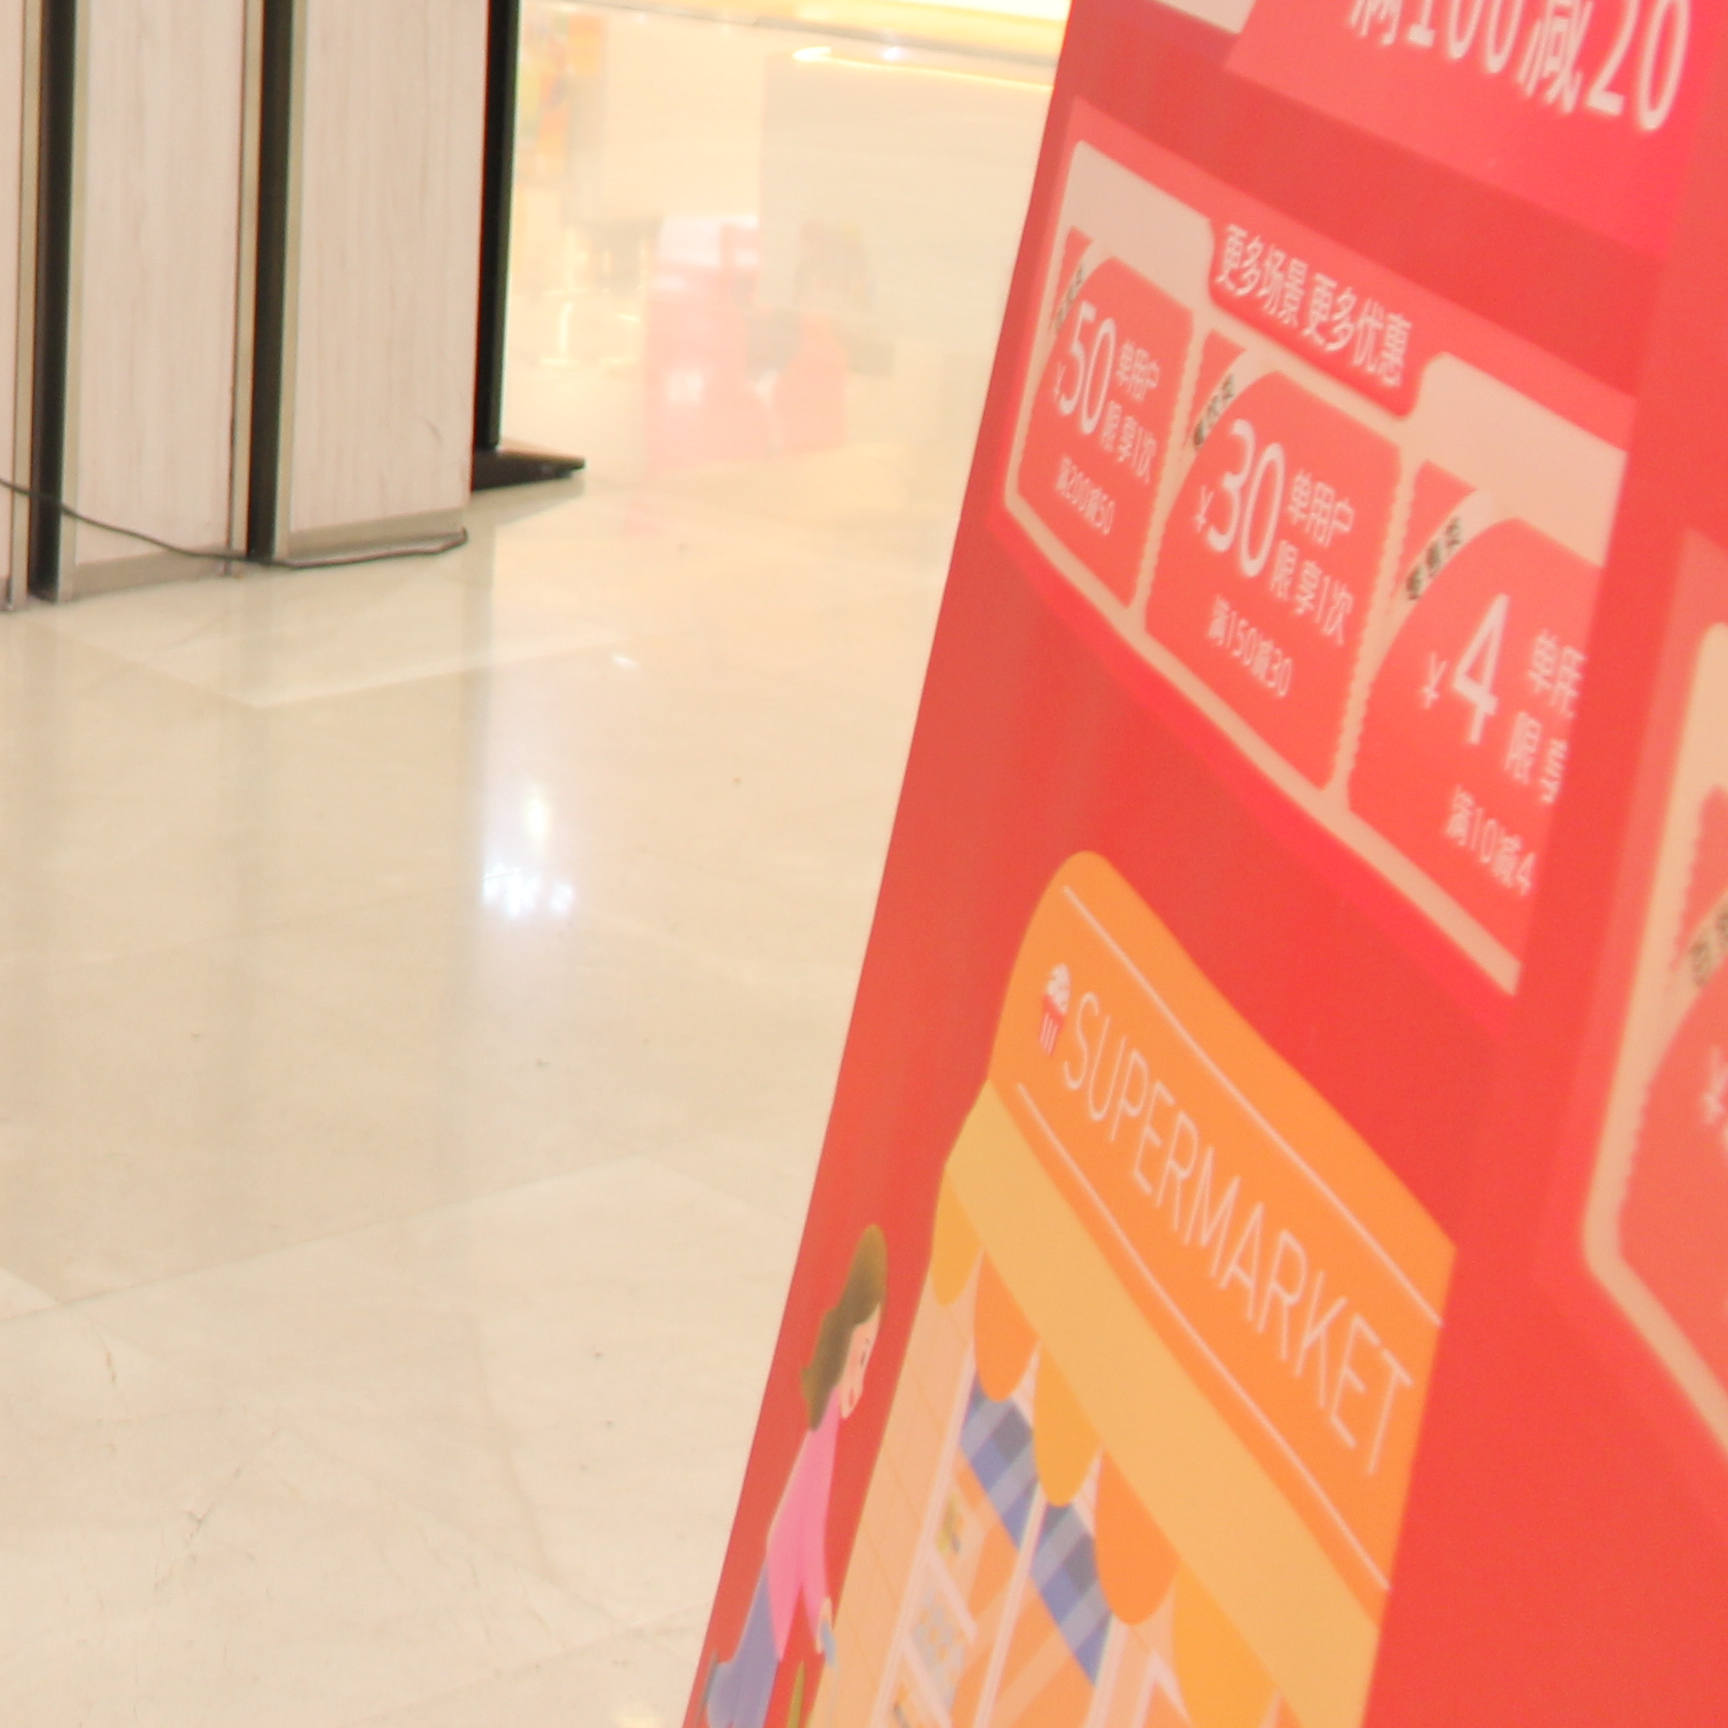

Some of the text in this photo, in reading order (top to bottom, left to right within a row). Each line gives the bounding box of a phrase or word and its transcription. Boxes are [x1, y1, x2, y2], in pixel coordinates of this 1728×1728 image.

[1215, 223, 1309, 327] 更多场景
[1302, 273, 1413, 388] 更多优惠
[1288, 468, 1355, 548] 单用户
[1063, 991, 1412, 1475] SUPERMARKET
